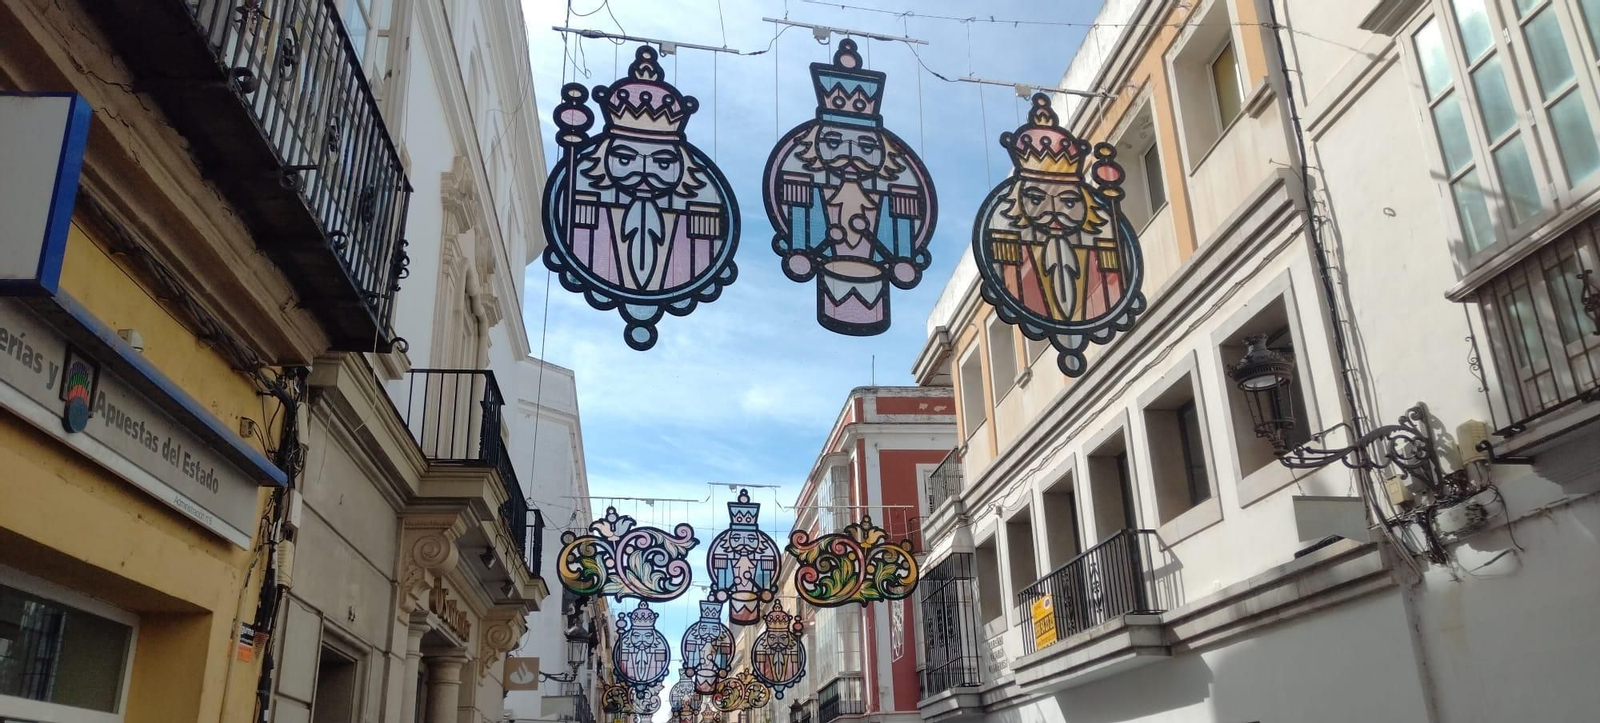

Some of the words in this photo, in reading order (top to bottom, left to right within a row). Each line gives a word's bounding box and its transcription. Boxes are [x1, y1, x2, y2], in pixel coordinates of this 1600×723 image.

[45, 360, 59, 391] y
[94, 389, 159, 453] Apuestas
[162, 436, 181, 469] del
[182, 451, 219, 494] Estado
